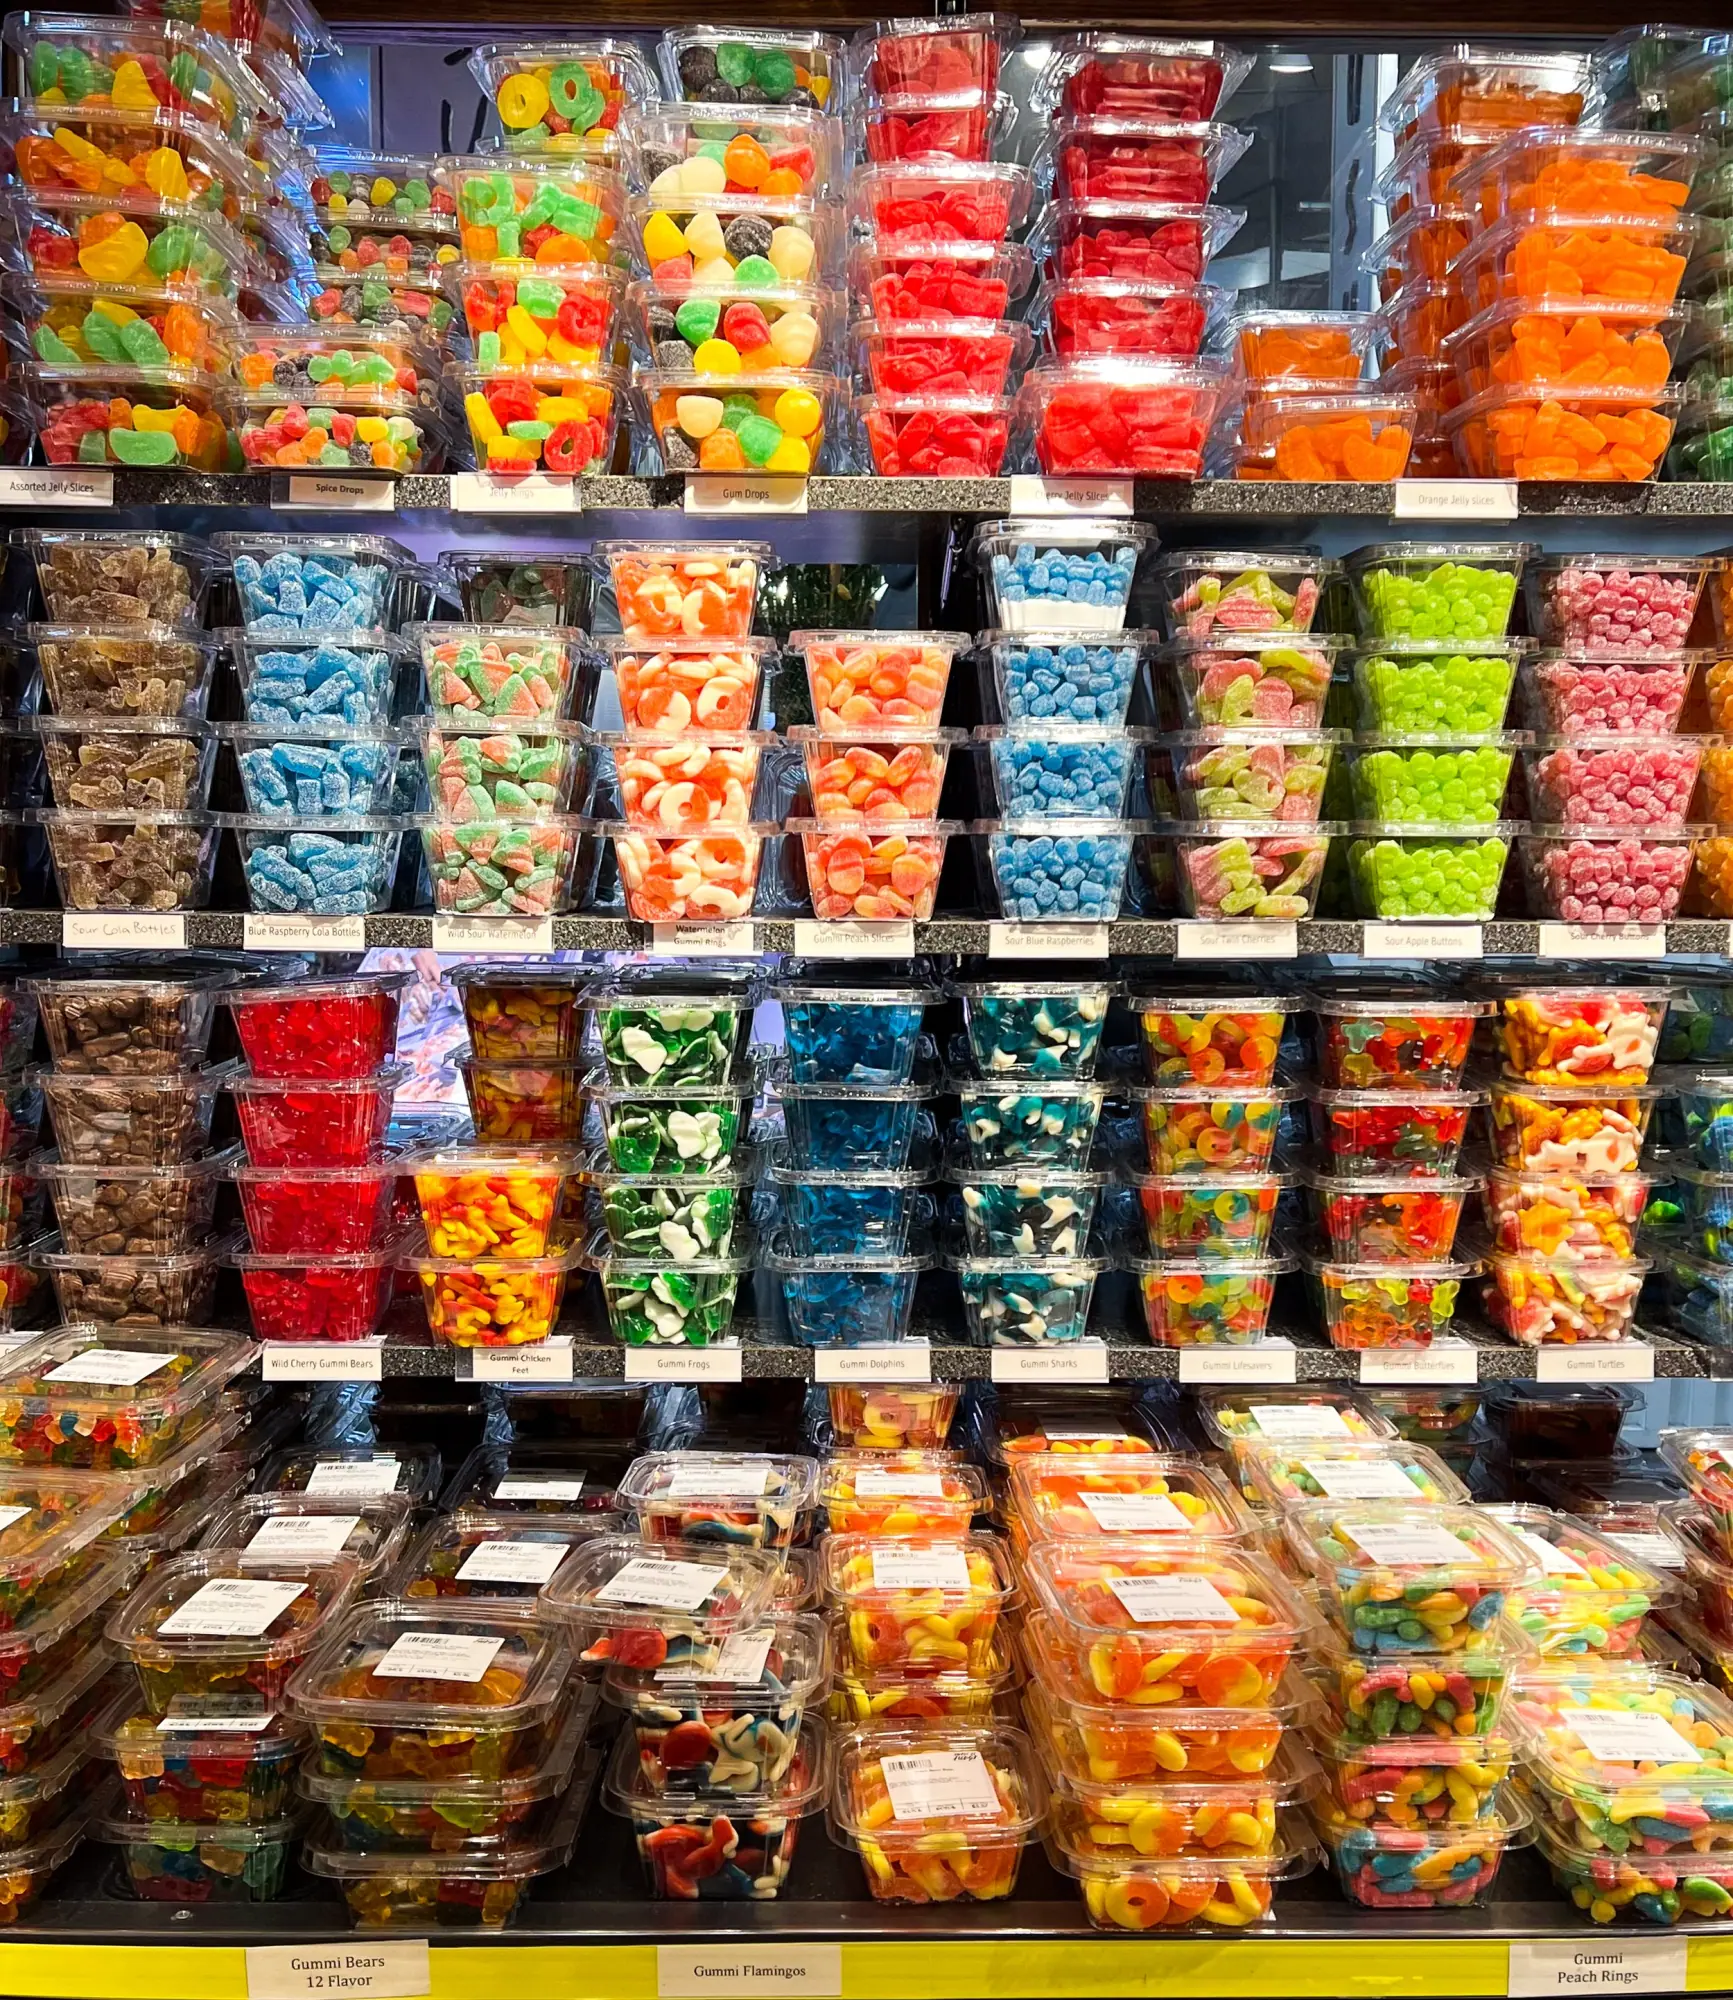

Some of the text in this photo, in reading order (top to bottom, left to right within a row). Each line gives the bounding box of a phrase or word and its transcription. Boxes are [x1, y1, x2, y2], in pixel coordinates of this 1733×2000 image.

[10, 482, 94, 493] Assorted Jelly Slices
[316, 483, 364, 496] Spice Drops
[489, 487, 534, 499] Jelly Rngs
[723, 489, 770, 500] Gum Drops
[1065, 490, 1084, 501] Jelly
[1086, 490, 1109, 500] Slices
[1418, 495, 1495, 506] Orange Jelly slices
[72, 922, 177, 936] Sour Cola Bottles
[248, 927, 361, 938] Blue Raspberry Cola Bottles
[448, 930, 537, 939] Wild Sour Watermelon
[676, 925, 726, 934] Watermelon
[674, 937, 727, 948] Gummi Rings
[813, 934, 894, 944] Gummi Peach Slices
[1004, 936, 1095, 947] Sour Blue Raspberries
[1200, 936, 1219, 945] Sour
[1241, 935, 1275, 944] Cherries
[1384, 936, 1463, 948] Sour Apple Buttons
[1570, 932, 1649, 943] Sour Cherry Buttons
[489, 1354, 551, 1363] Gummi Chicken
[1020, 1359, 1078, 1368] Gummi Sharks
[271, 1359, 374, 1370] Wild Cherry Gummi Bears
[657, 1359, 711, 1370] Gummi Frogs
[839, 1359, 905, 1370] Gummi Dolphins
[1202, 1361, 1272, 1370] Gummi Lifesavers
[1383, 1361, 1455, 1370] Gummi Butterflies
[1566, 1360, 1625, 1369] Gummi Turtles
[291, 1956, 386, 1971] Gummi Bears
[1574, 1952, 1624, 1966] Gummi
[694, 1965, 807, 1980] Gummi Flamingos
[1557, 1969, 1638, 1985] Peach Rings
[306, 1974, 374, 1988] 12 Flavor
